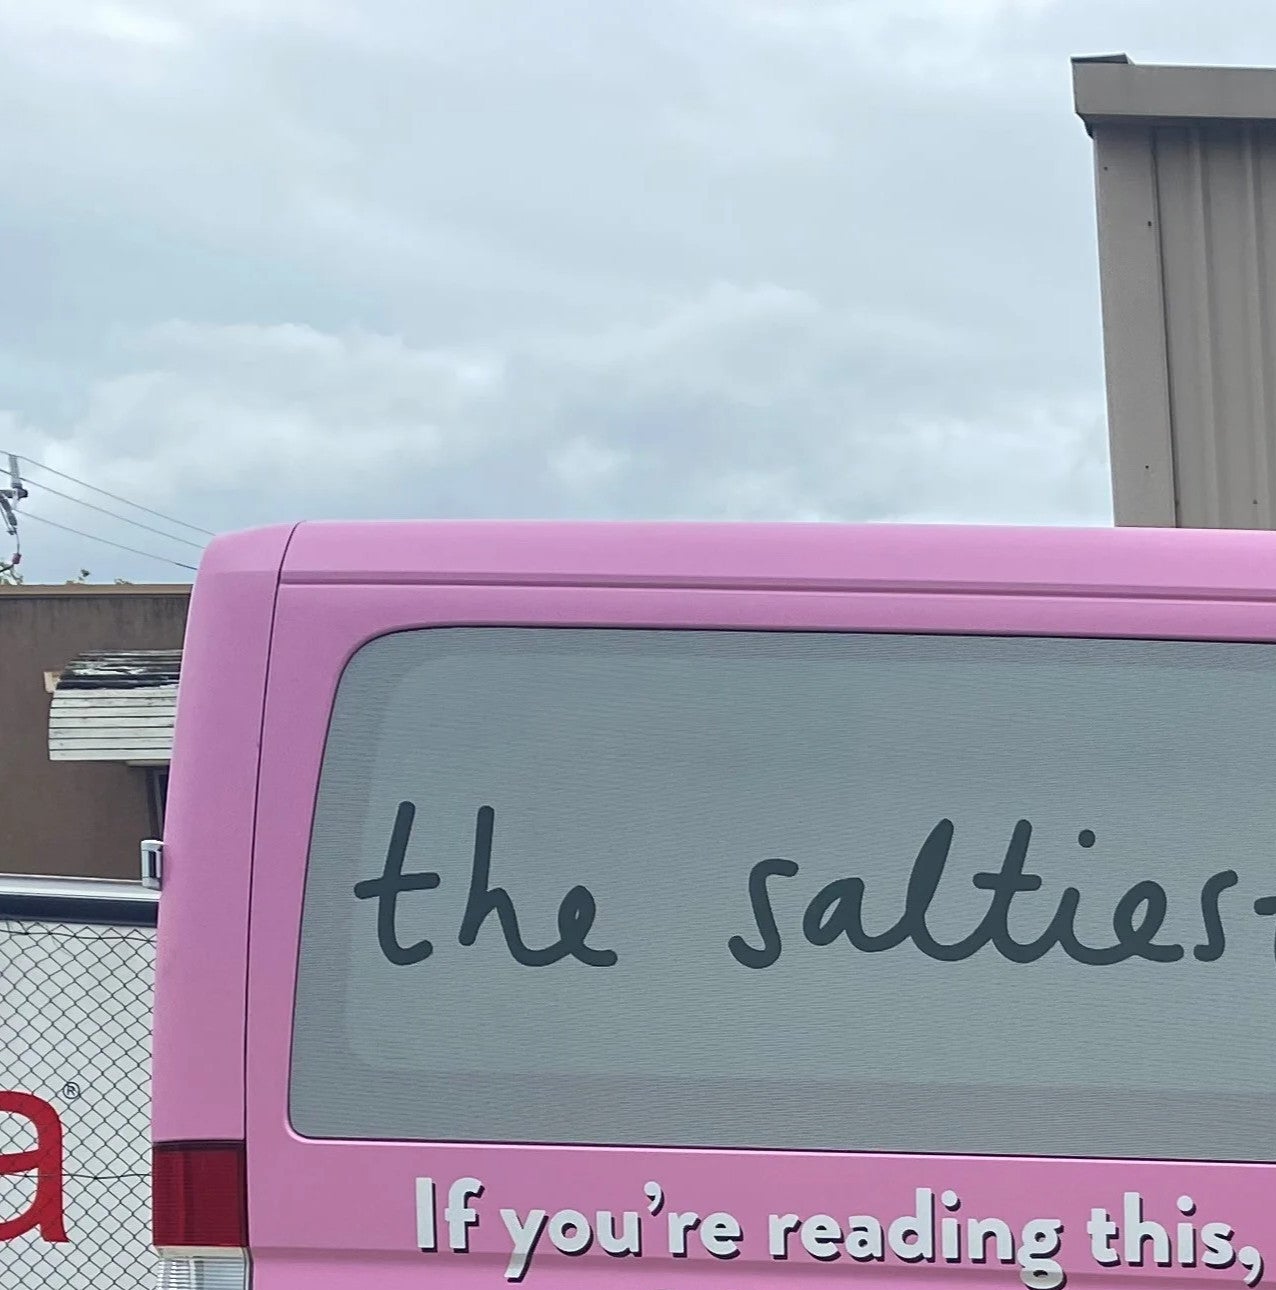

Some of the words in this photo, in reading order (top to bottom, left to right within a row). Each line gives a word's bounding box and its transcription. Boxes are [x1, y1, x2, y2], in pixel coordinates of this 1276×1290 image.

[354, 800, 618, 968] the
[415, 1176, 484, 1253] If
[500, 1180, 742, 1280] you're
[1087, 1191, 1266, 1284] this,
